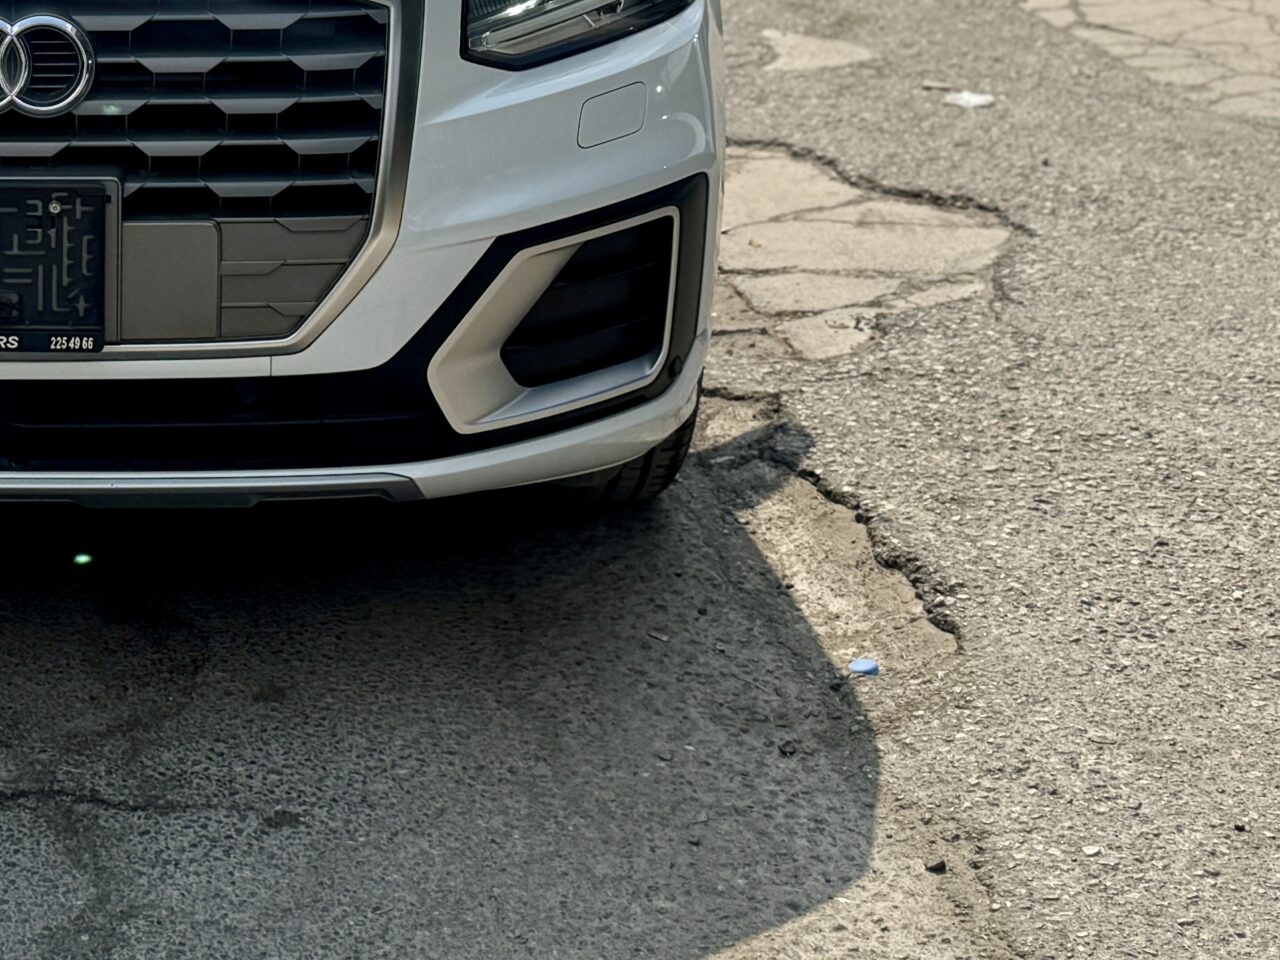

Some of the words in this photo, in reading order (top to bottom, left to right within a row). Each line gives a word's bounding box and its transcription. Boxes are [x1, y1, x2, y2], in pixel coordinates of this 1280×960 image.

[50, 336, 68, 350] 225
[68, 336, 81, 350] 49
[81, 336, 94, 350] 66
